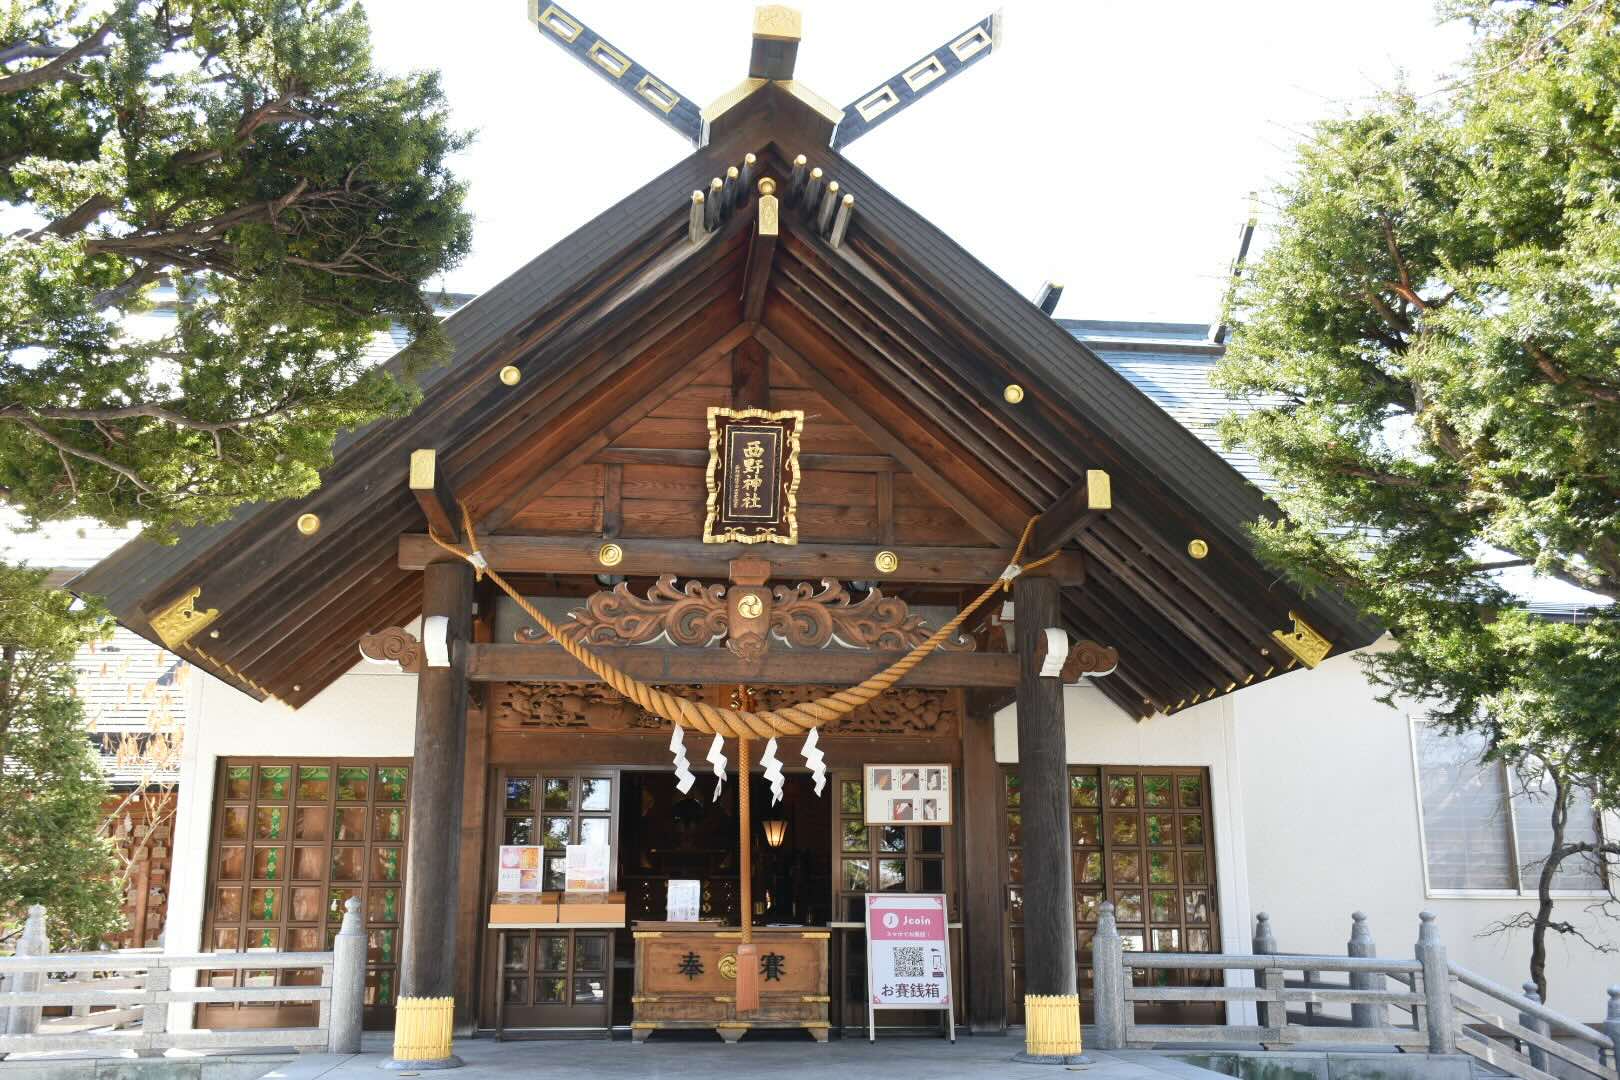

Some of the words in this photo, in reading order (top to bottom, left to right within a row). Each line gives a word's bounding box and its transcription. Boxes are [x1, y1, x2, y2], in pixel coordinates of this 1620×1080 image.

[741, 440, 765, 509] 西野神社
[678, 951, 705, 981] 奉
[760, 952, 787, 982] 賽
[881, 983, 940, 998] お賽銭箱
